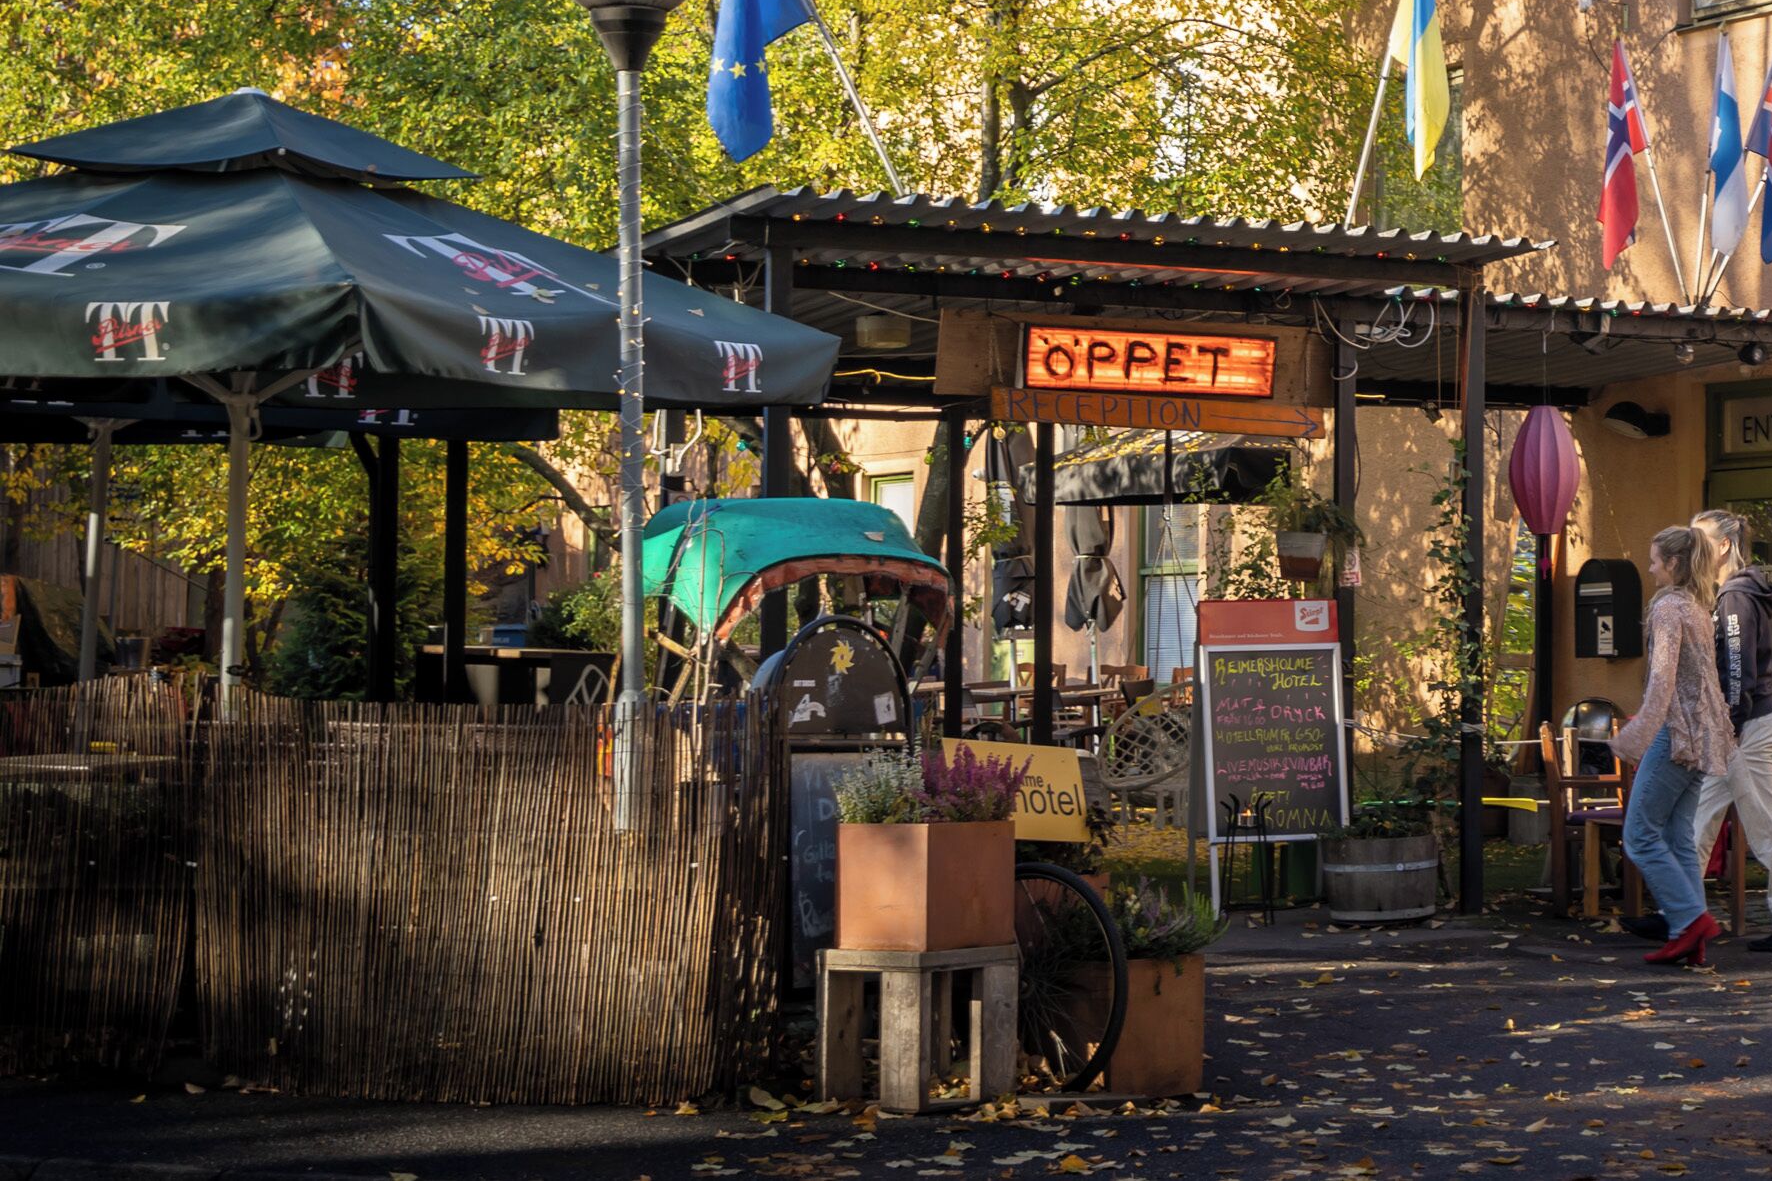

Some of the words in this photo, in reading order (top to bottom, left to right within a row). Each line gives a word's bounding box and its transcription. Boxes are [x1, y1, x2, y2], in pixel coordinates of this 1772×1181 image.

[85, 301, 170, 361] TT
[478, 315, 535, 375] TT
[714, 340, 763, 393] TT
[1008, 389, 1201, 428] RECEPTION
[1727, 614, 1738, 625] 19
[1727, 625, 1740, 637] 52
[1269, 672, 1323, 690] HOTEL
[1270, 705, 1326, 723] DRYCK
